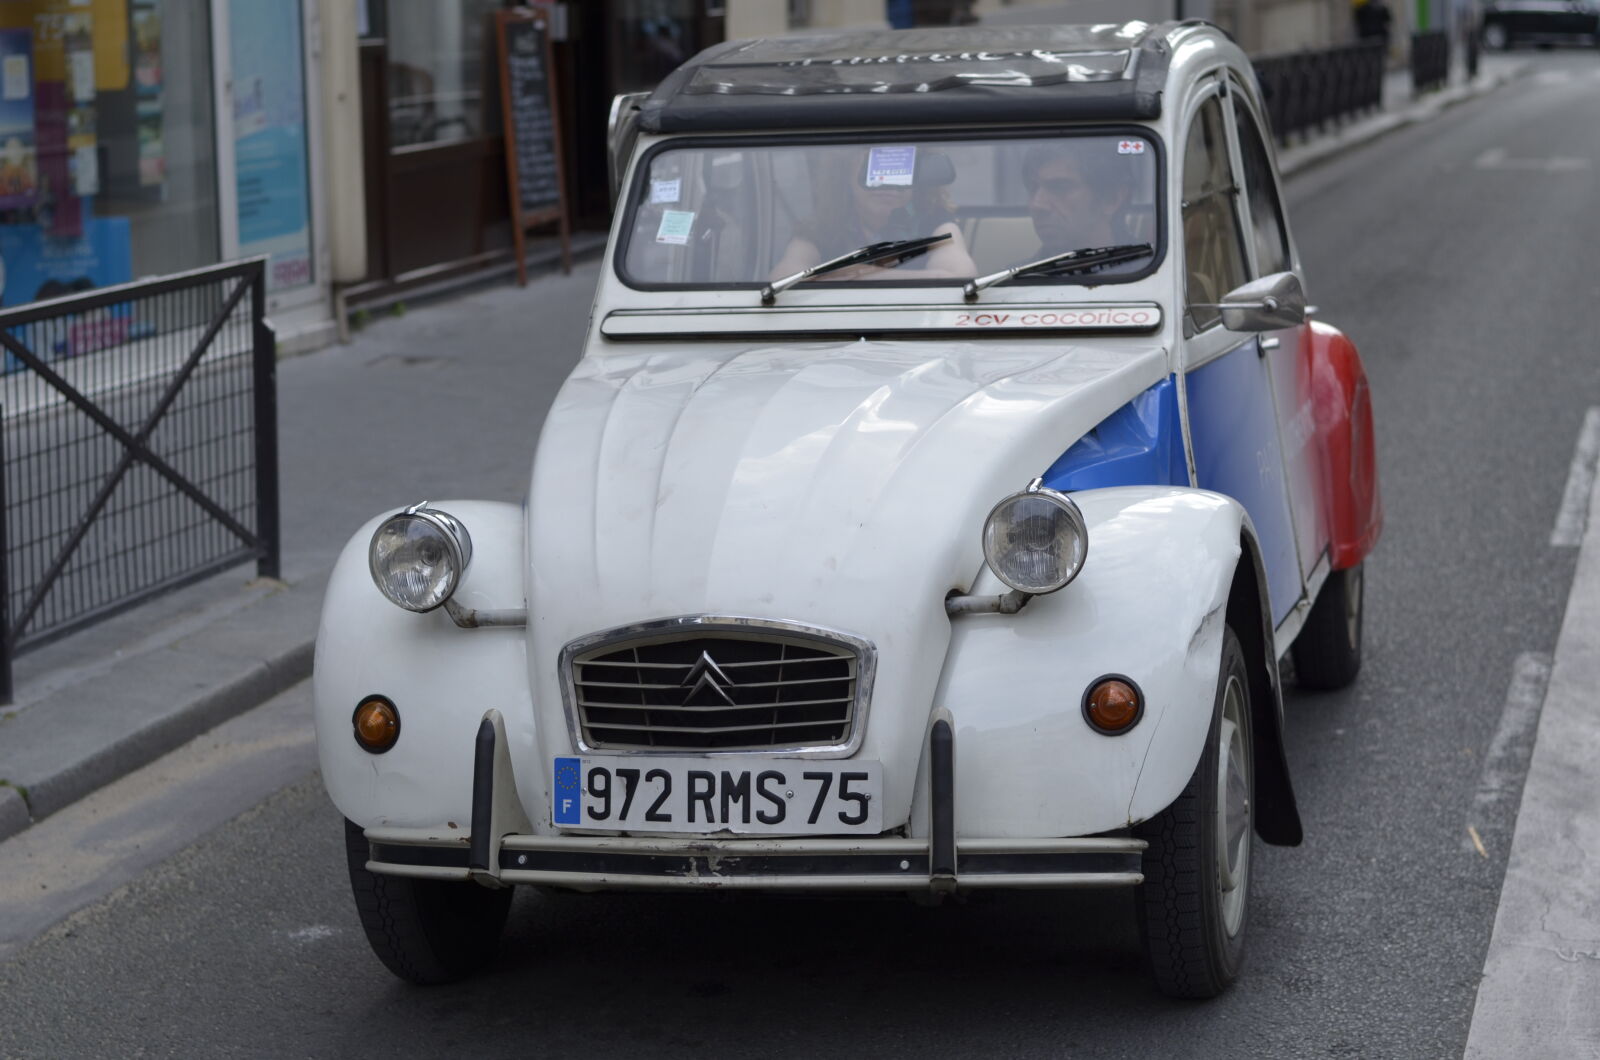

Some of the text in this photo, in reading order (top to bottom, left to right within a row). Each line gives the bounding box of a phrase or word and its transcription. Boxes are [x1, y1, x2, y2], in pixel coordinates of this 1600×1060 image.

[562, 799, 573, 814] F
[587, 766, 872, 826] 972 RMS 75
